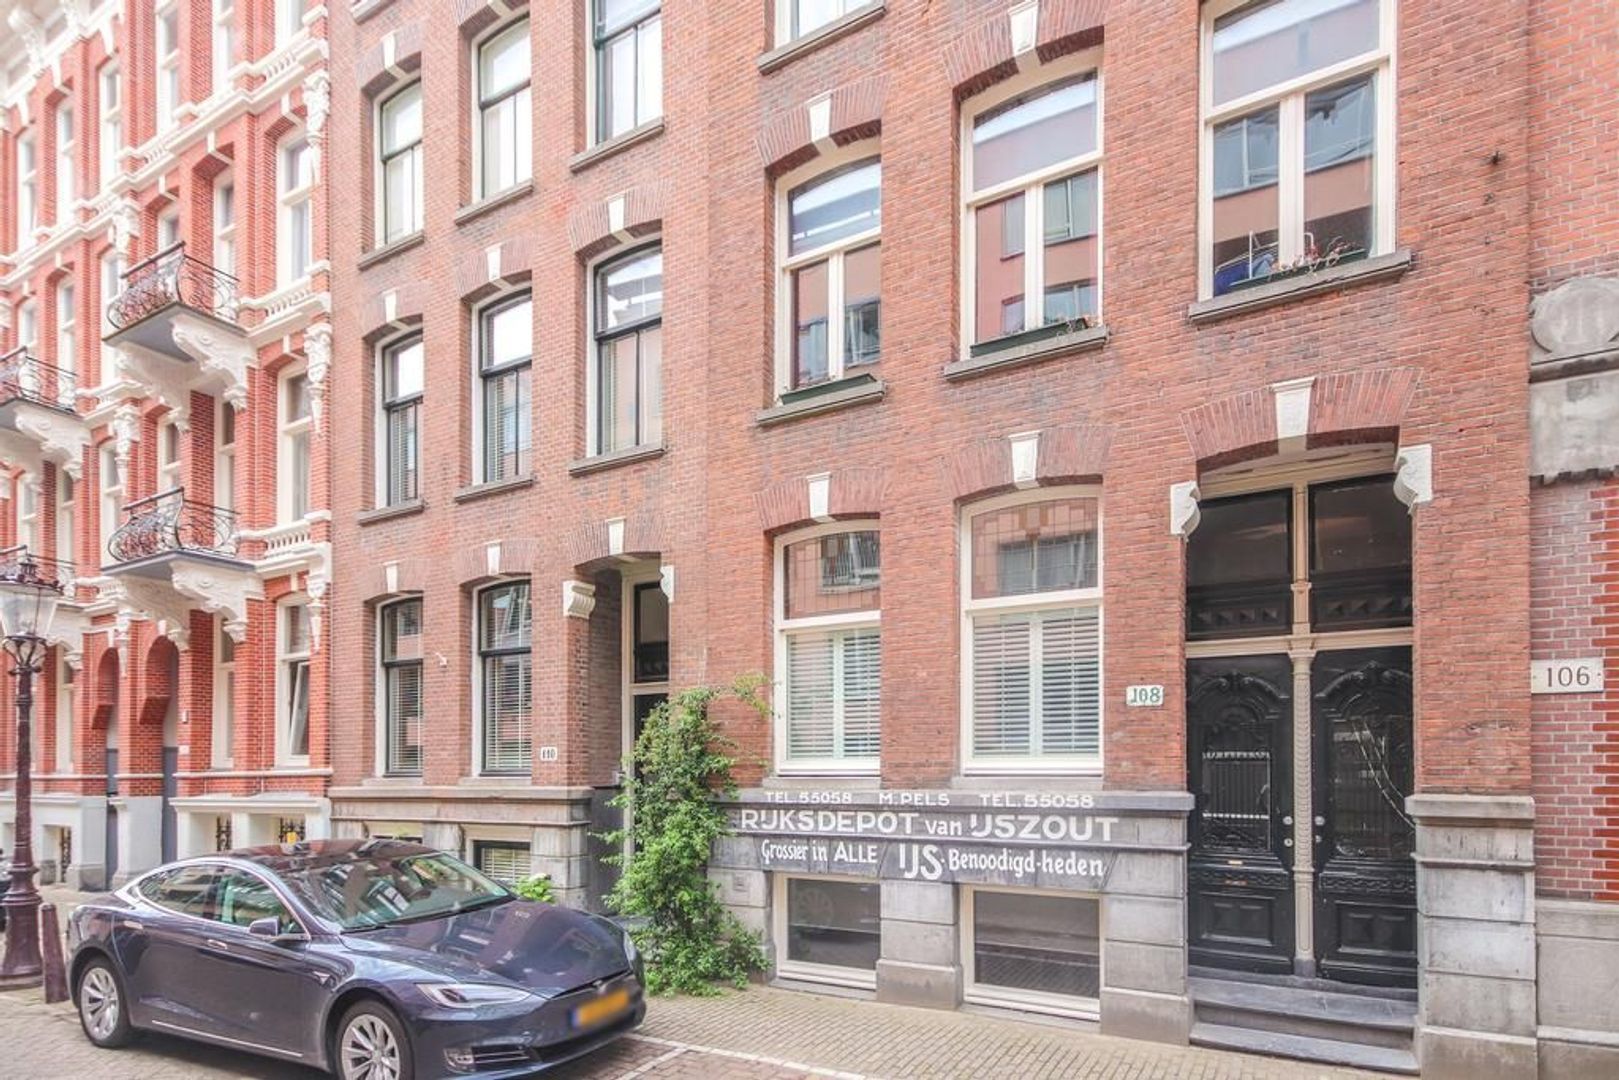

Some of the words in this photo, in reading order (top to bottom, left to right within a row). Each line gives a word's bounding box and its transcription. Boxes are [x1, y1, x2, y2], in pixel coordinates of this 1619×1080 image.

[1547, 665, 1590, 687] 106
[1131, 687, 1160, 703] 108
[925, 819, 962, 836] van
[761, 839, 808, 865] Grossier
[812, 840, 828, 862] in
[834, 841, 877, 863] ALLE
